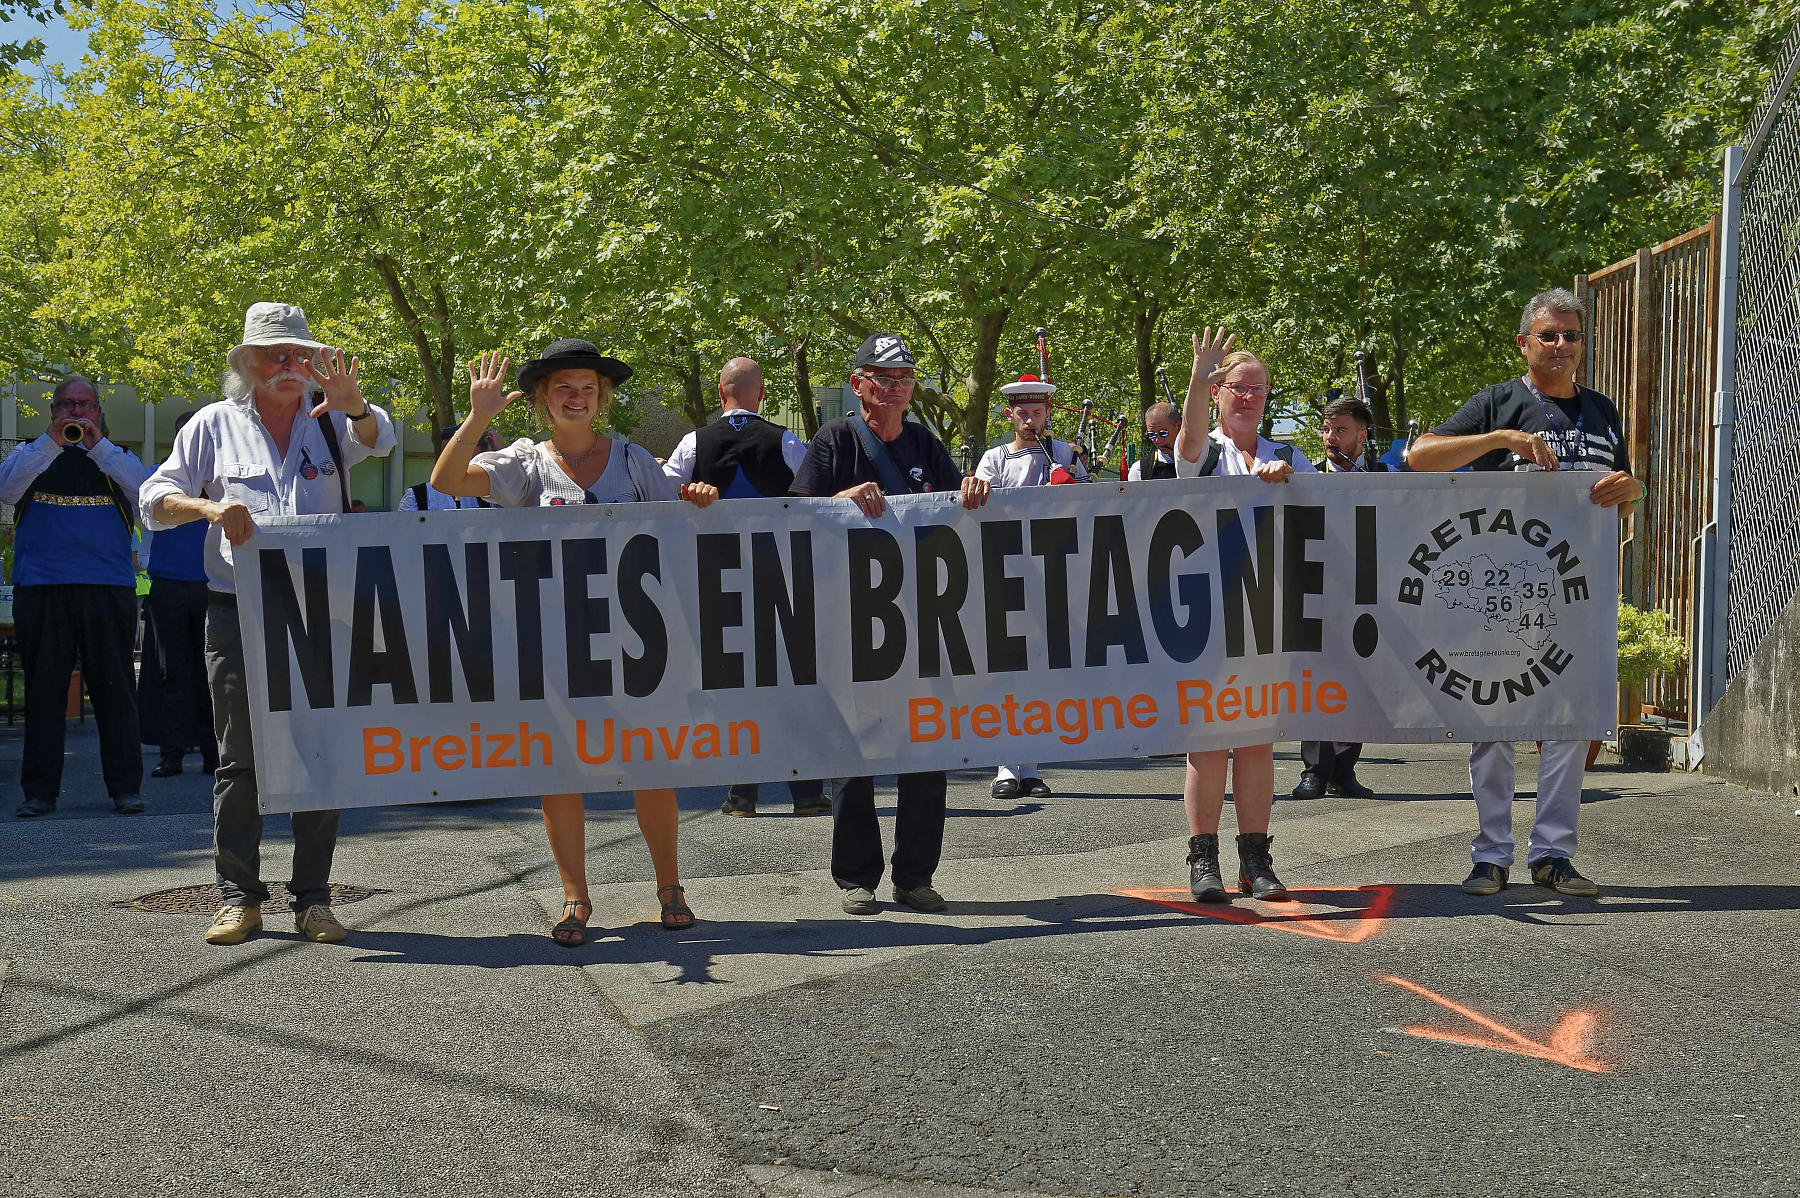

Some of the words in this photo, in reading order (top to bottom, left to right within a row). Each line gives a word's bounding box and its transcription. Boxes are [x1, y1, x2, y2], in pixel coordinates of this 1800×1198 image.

[1397, 507, 1590, 607] BRETAGNE
[1443, 569, 1471, 587] 29
[1484, 569, 1510, 587] 22
[1522, 582, 1549, 600] 35
[258, 532, 669, 713] NANTES
[696, 530, 818, 691] EN
[847, 504, 1326, 683] BRETAGNE
[1352, 505, 1379, 658] !
[1485, 595, 1513, 613] 56
[1519, 613, 1546, 630] 44
[1448, 648, 1521, 658] www.bretagne-reunie.org
[908, 692, 1159, 745] Bretagne
[1176, 669, 1349, 726] Réunie
[362, 721, 554, 776] Breizh
[575, 717, 761, 766] Unvan
